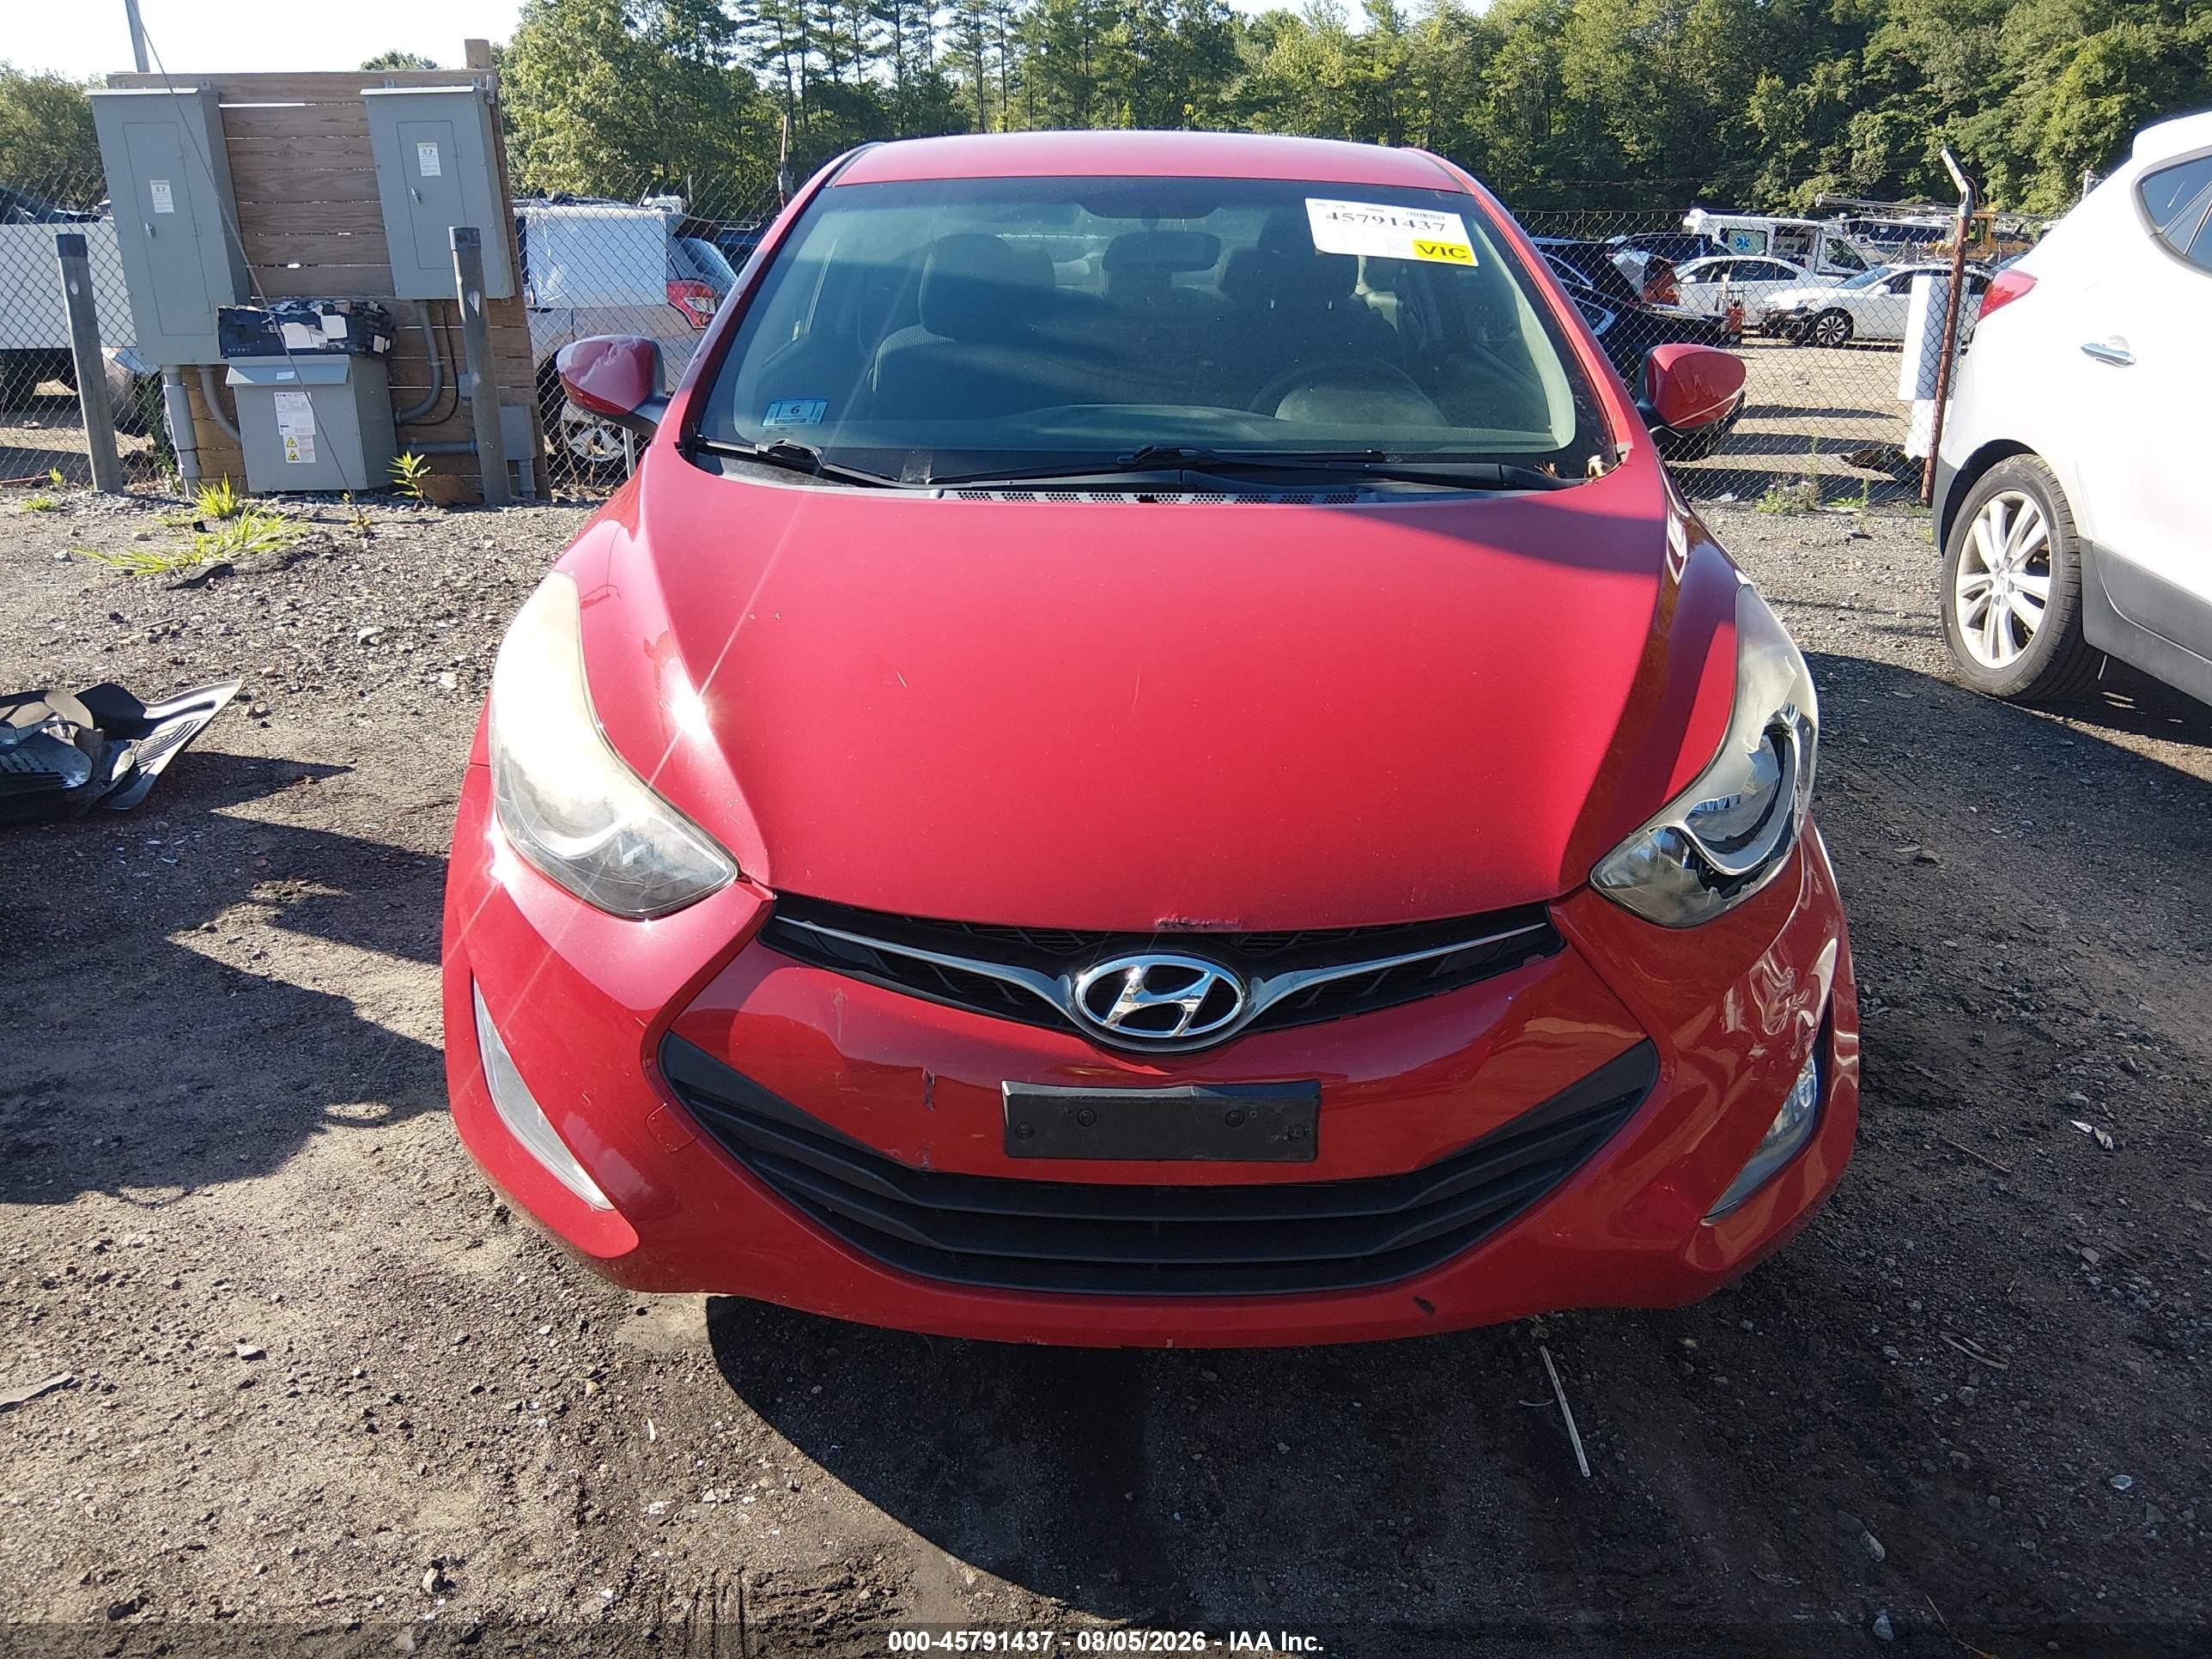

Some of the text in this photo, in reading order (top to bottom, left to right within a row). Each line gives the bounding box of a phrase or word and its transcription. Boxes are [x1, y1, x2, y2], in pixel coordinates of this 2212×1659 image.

[1325, 211, 1446, 233] 45791437
[1417, 244, 1468, 258] VIC
[790, 404, 801, 415] 6
